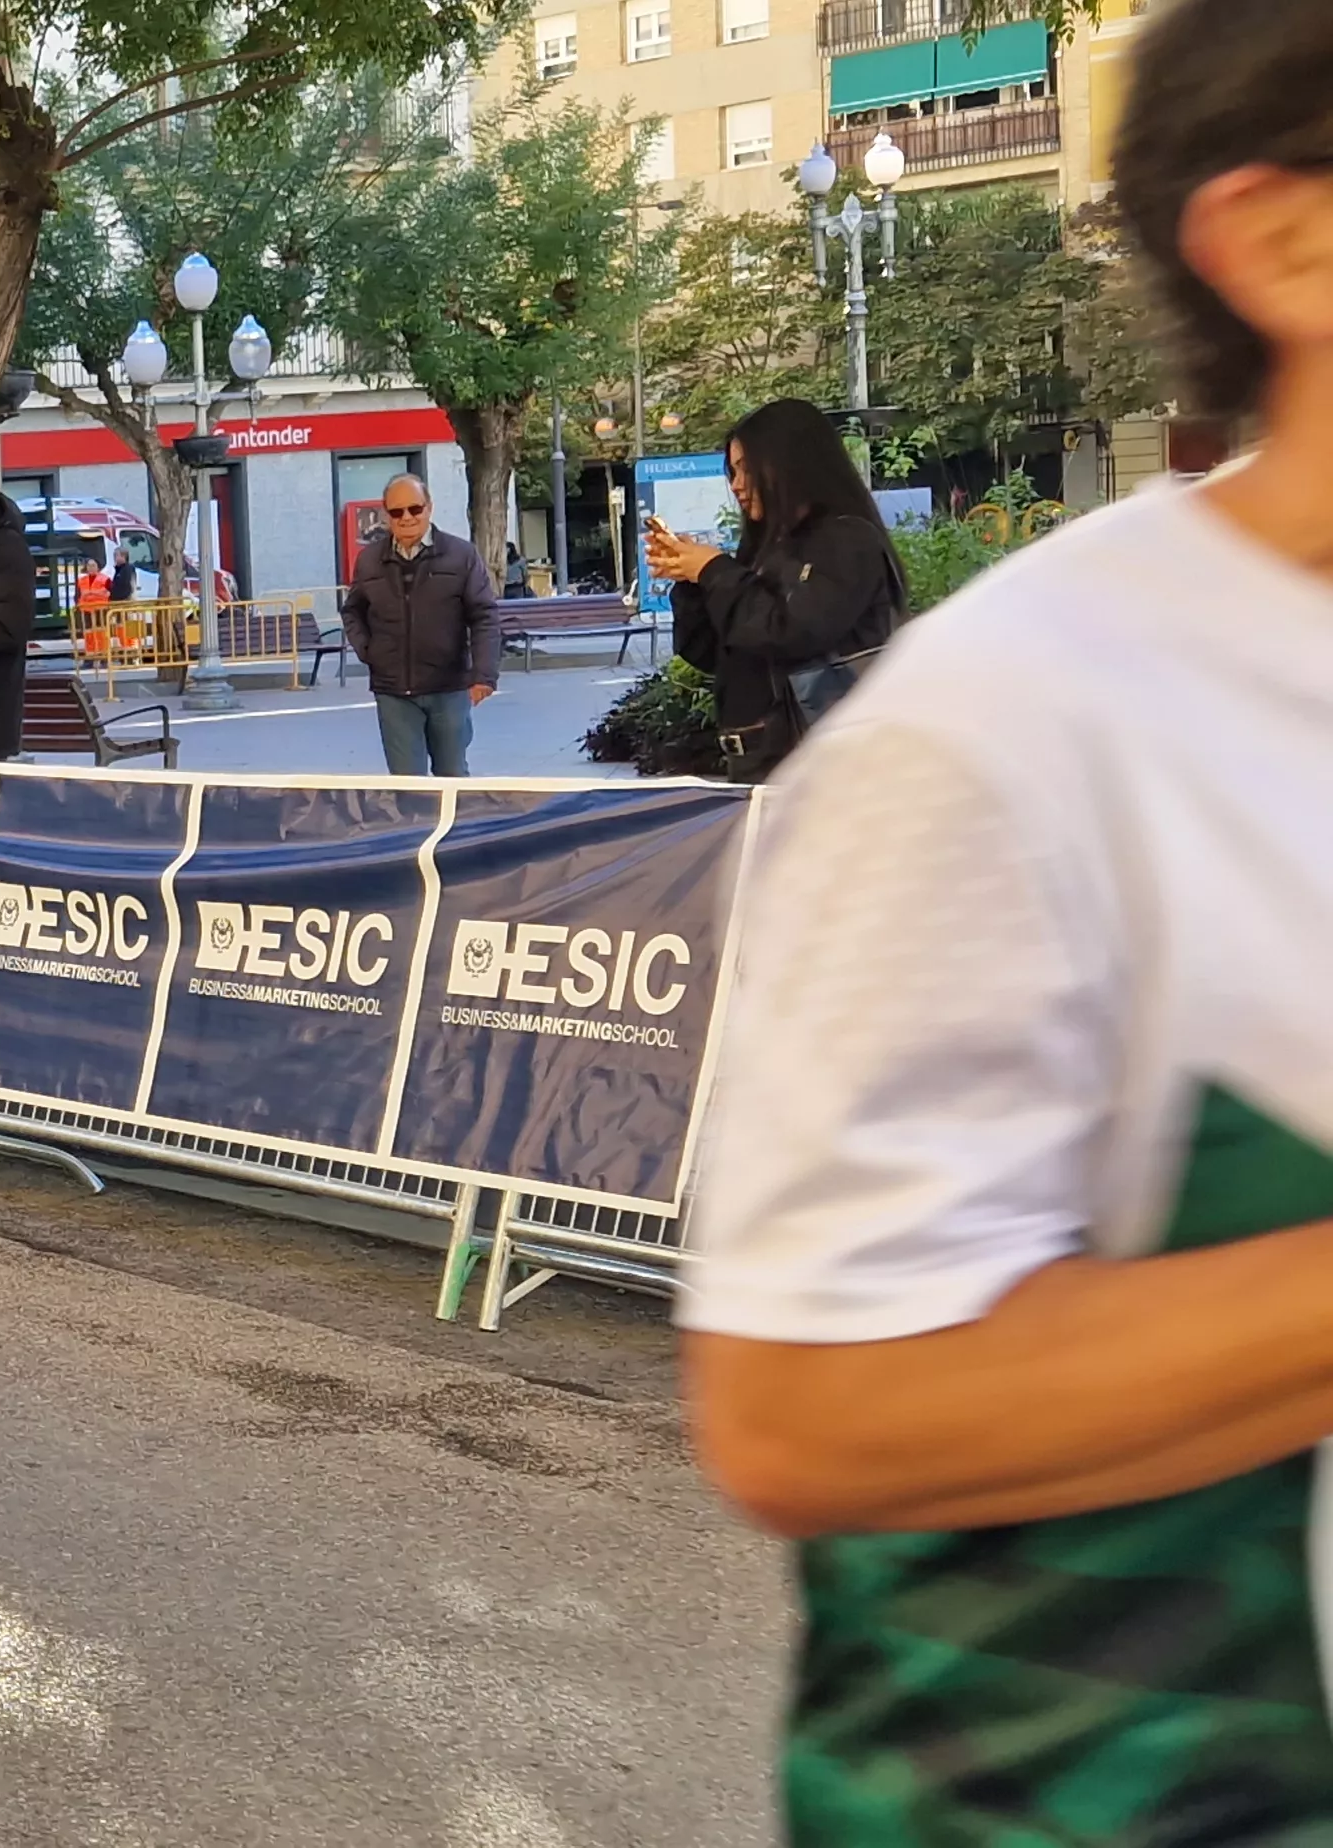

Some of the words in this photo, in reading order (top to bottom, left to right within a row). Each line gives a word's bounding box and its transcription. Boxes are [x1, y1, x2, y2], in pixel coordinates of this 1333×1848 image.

[644, 461, 697, 474] HUESCA
[26, 886, 149, 961] ESIC
[244, 904, 393, 987] ESIC
[505, 922, 691, 1016] ESIC
